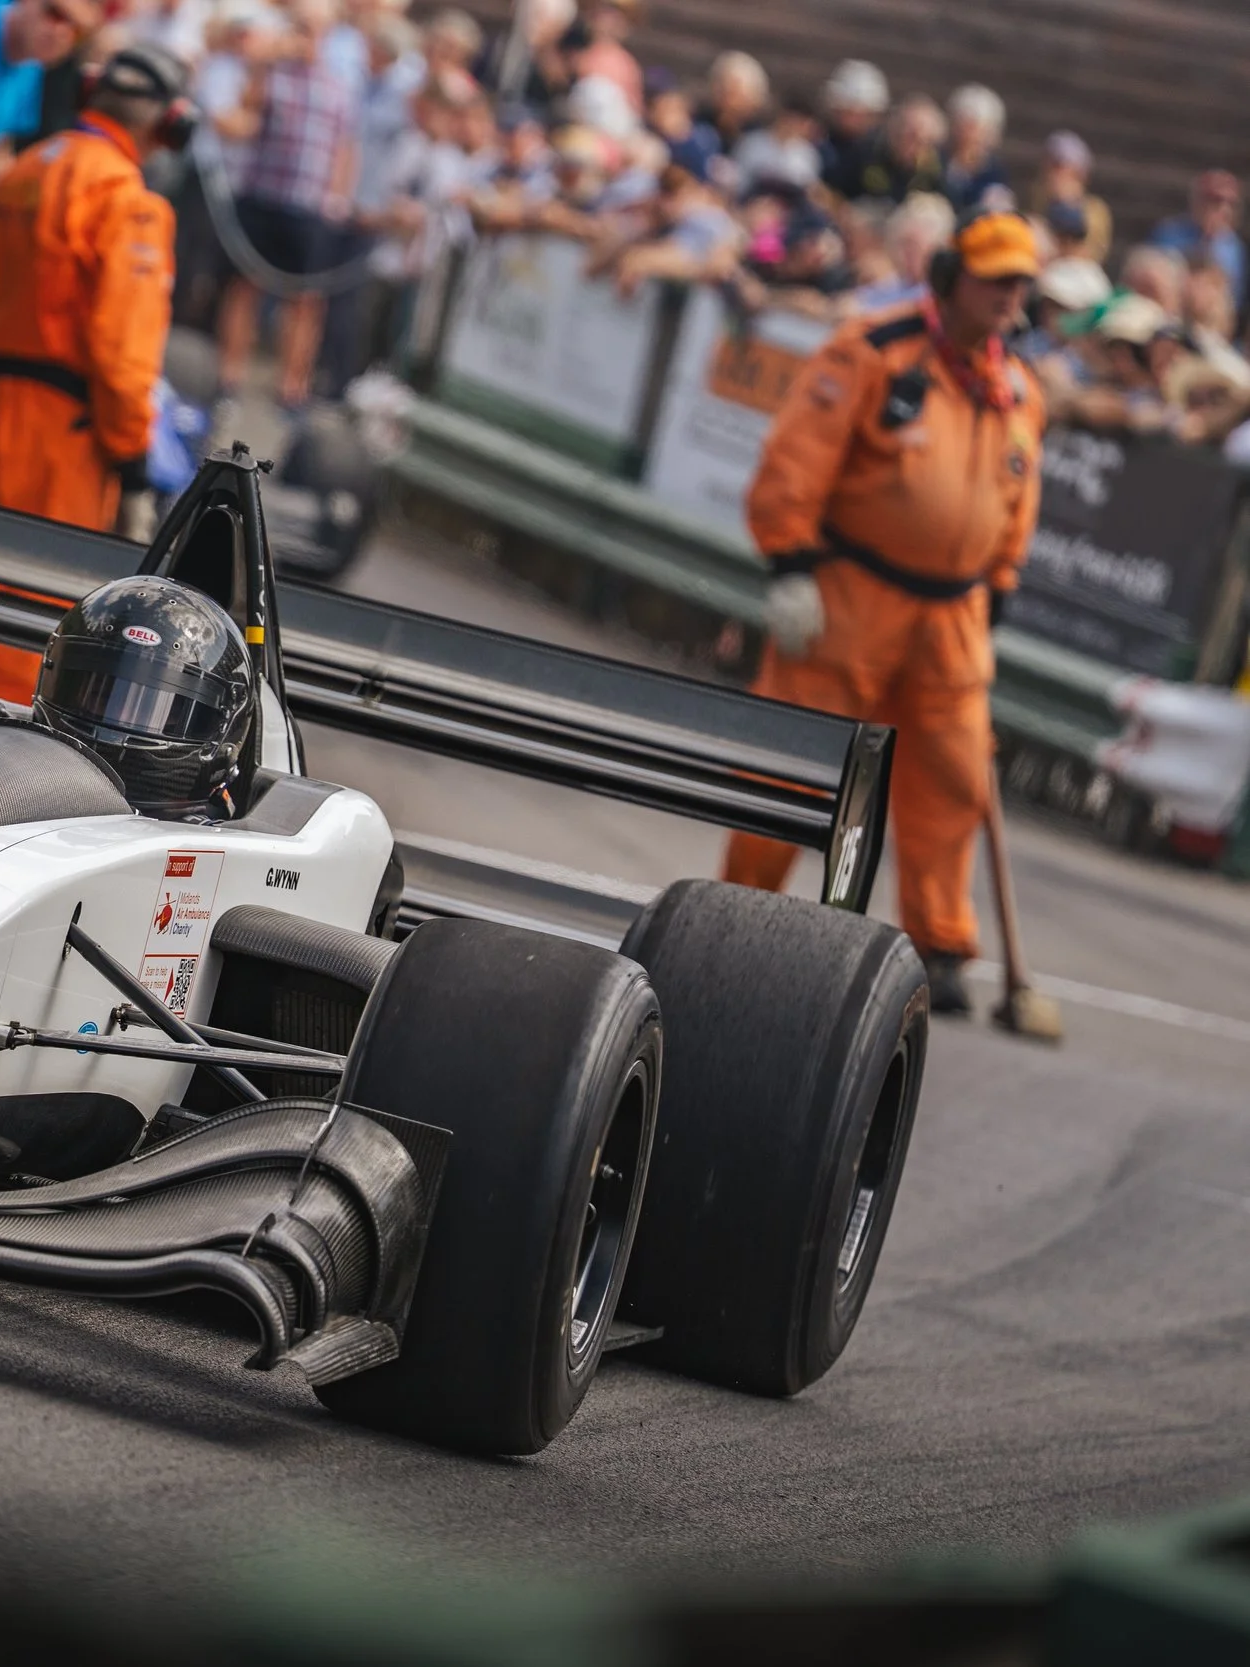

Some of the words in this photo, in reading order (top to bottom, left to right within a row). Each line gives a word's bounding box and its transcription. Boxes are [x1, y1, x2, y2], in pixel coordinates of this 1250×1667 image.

[128, 629, 157, 642] BELL
[265, 867, 301, 891] G.WYNN
[172, 923, 191, 938] Charity
